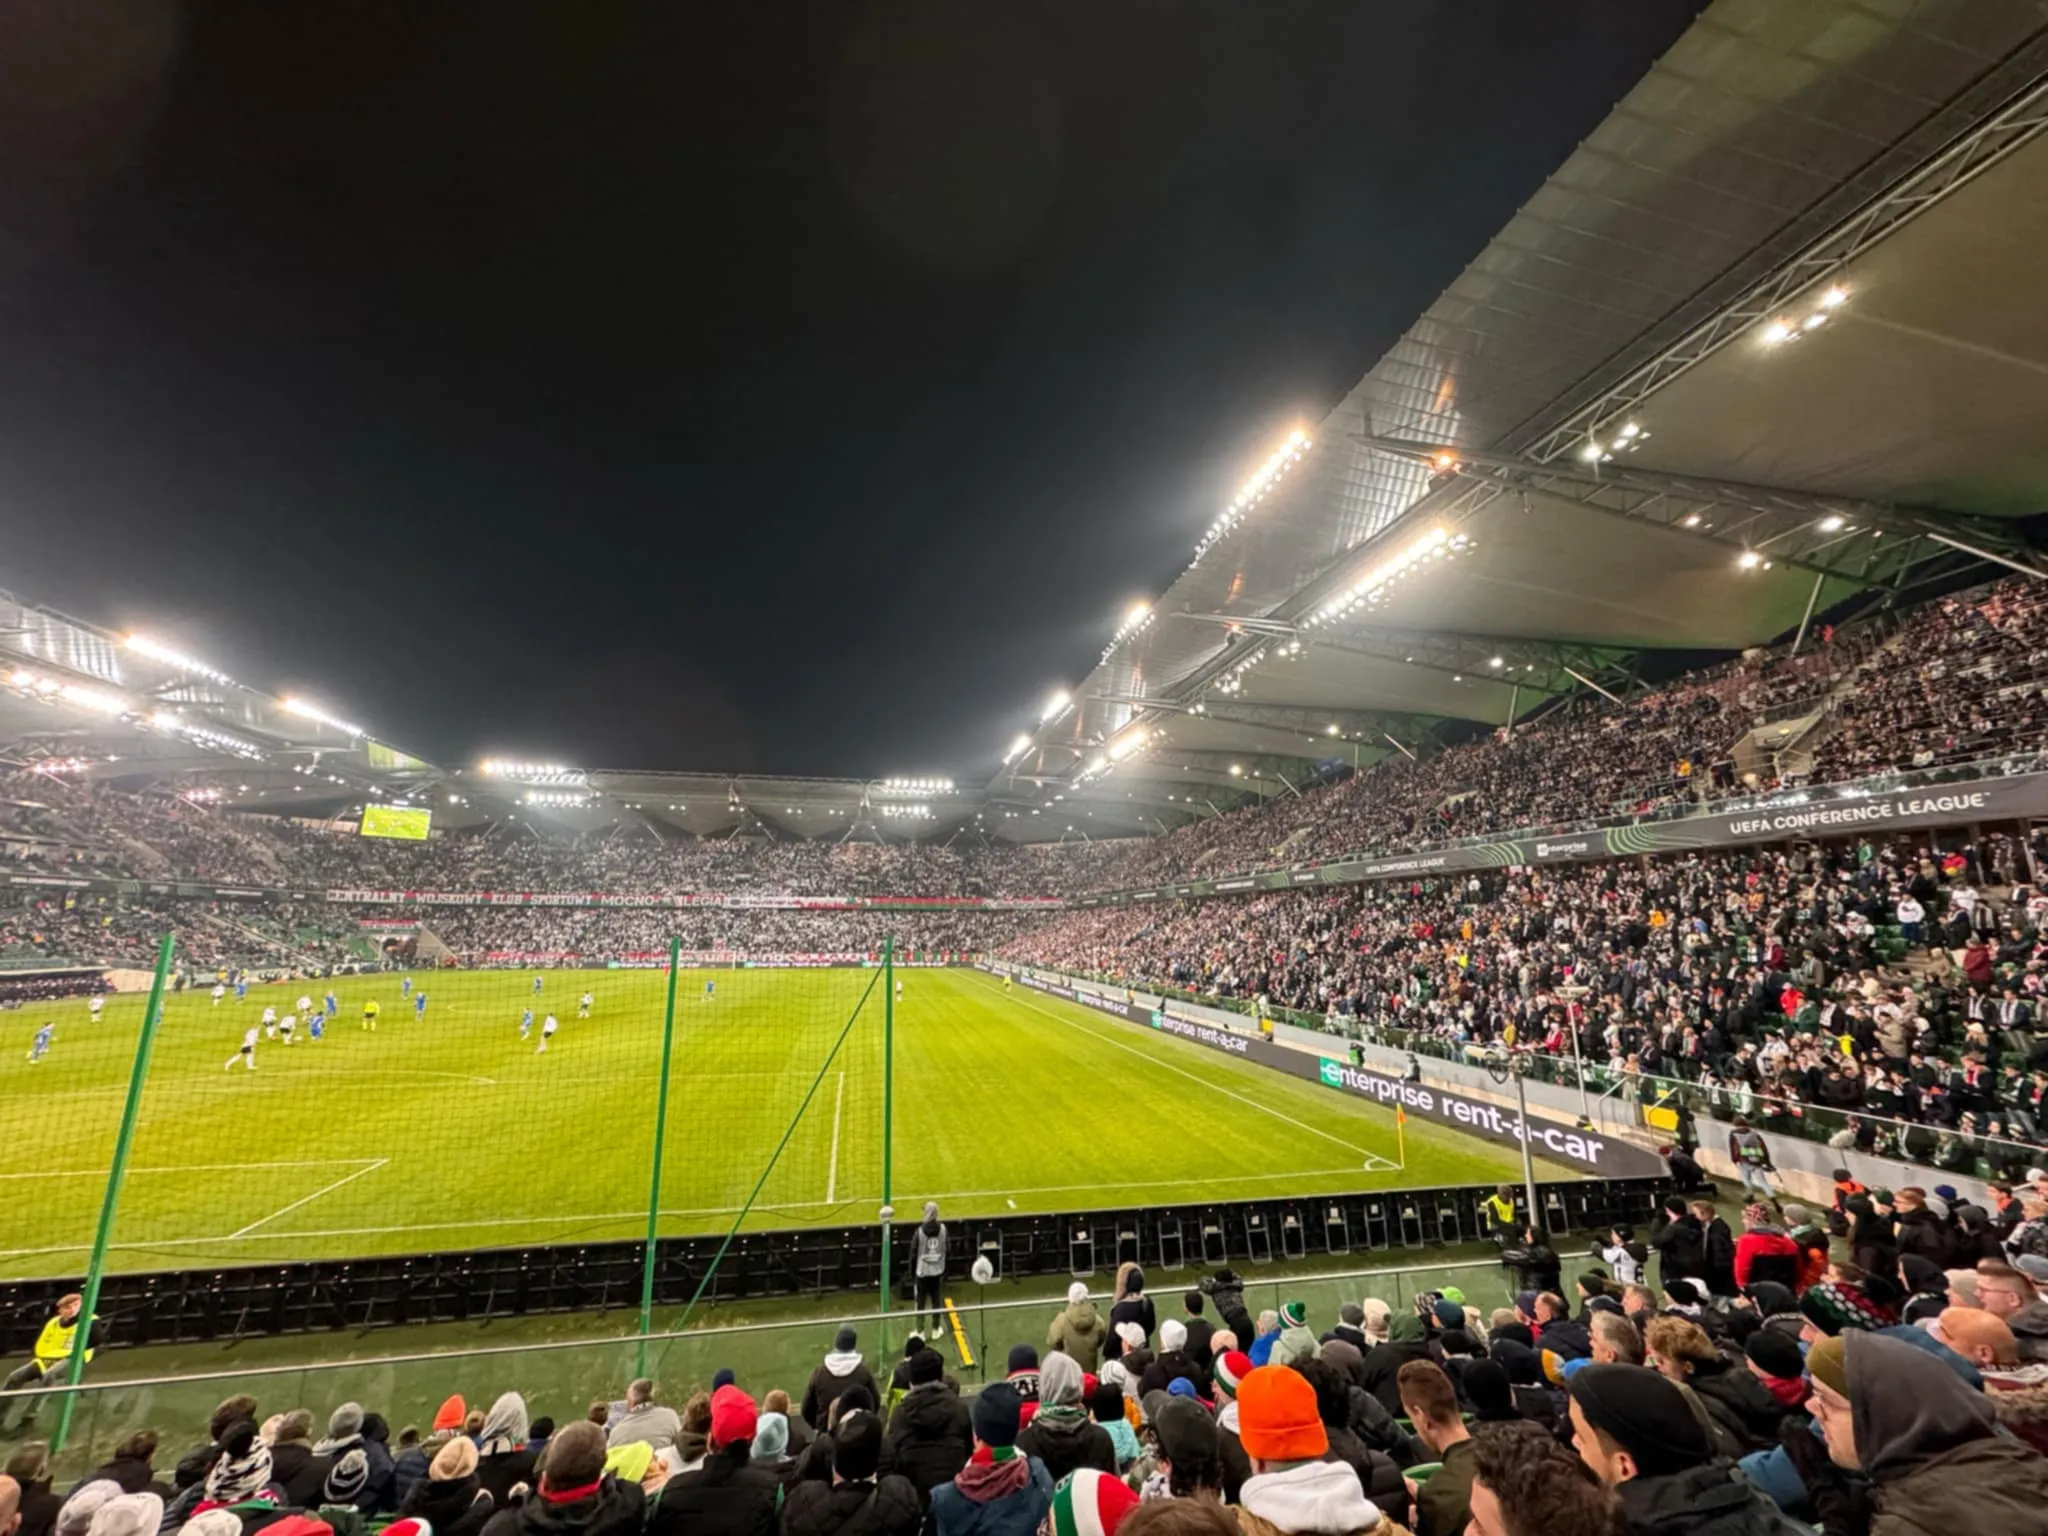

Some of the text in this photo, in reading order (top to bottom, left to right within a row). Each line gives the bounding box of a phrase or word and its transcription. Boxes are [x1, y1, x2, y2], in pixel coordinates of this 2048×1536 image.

[1730, 792, 1985, 834] UEFA CONFERENCE LEAGUE
[1320, 1062, 1604, 1164] enterprise rent-a-car
